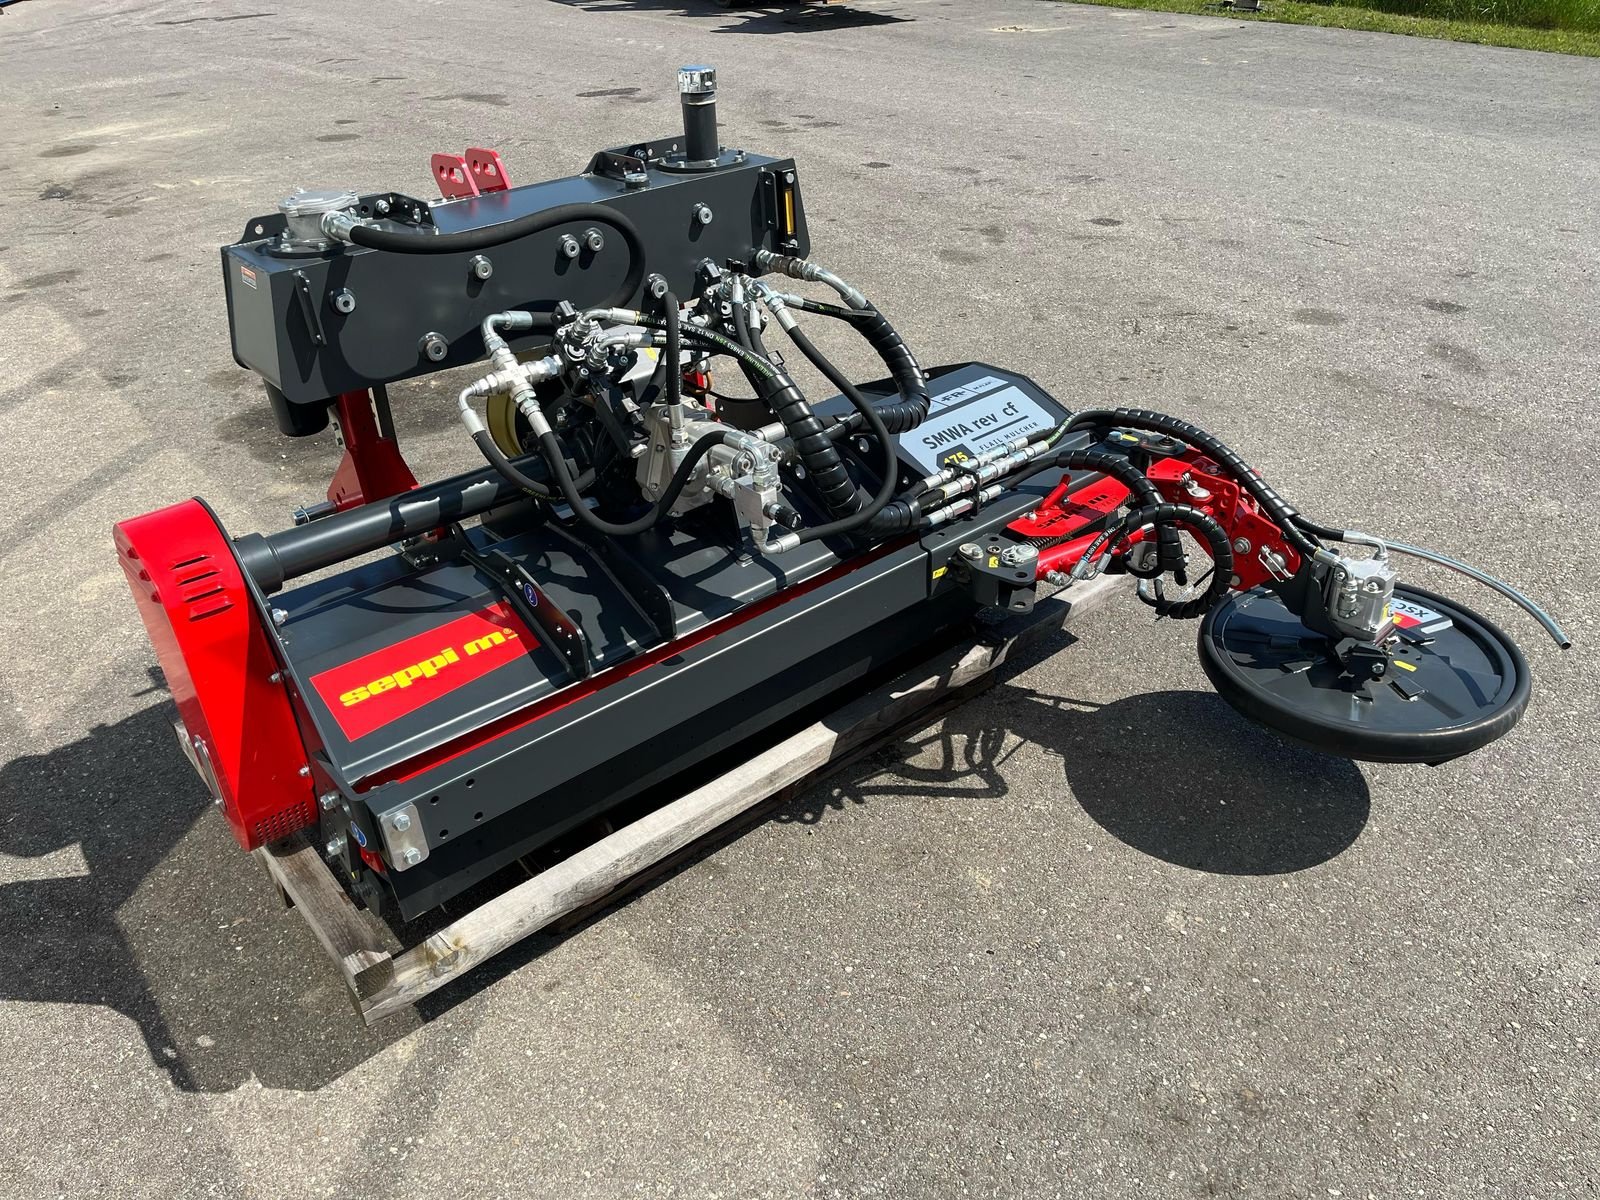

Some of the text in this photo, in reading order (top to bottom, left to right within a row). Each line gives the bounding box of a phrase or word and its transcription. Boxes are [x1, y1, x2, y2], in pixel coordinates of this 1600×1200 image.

[683, 324, 696, 332] SAE
[704, 331, 714, 339] DN
[727, 342, 744, 356] EN853
[922, 401, 1020, 450] SMWA rev cf
[979, 422, 1039, 451] FLAIL MULCHER
[1395, 602, 1430, 618] XSC
[339, 647, 461, 707] seppi
